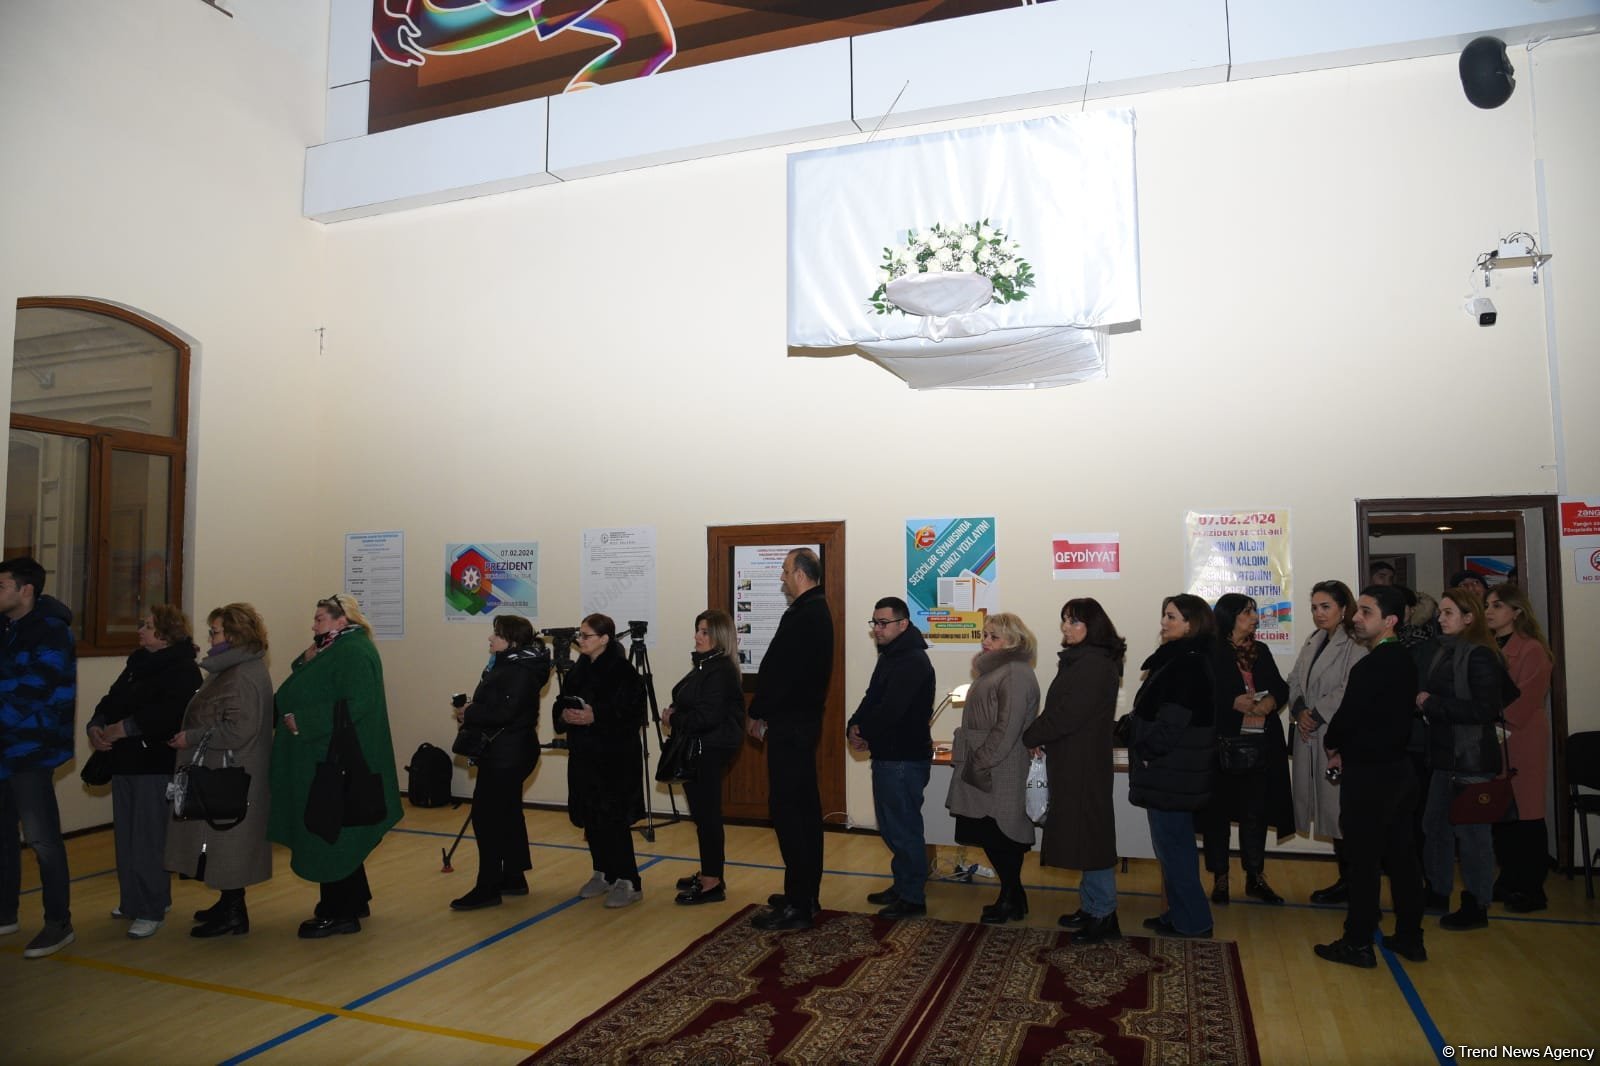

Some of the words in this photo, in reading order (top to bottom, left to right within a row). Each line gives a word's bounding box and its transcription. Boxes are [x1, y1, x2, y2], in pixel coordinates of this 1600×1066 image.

[501, 549, 534, 557] 07.02.2024
[908, 554, 939, 586] SEÇİCİLƏR
[935, 520, 972, 557] SİYAHISINDA
[937, 551, 961, 577] ADINIZI
[956, 519, 991, 554] YOXLAYIN!
[1055, 549, 1116, 563] QEYDİYYAT
[485, 560, 534, 571] PREZİDENT
[971, 630, 982, 639] 115
